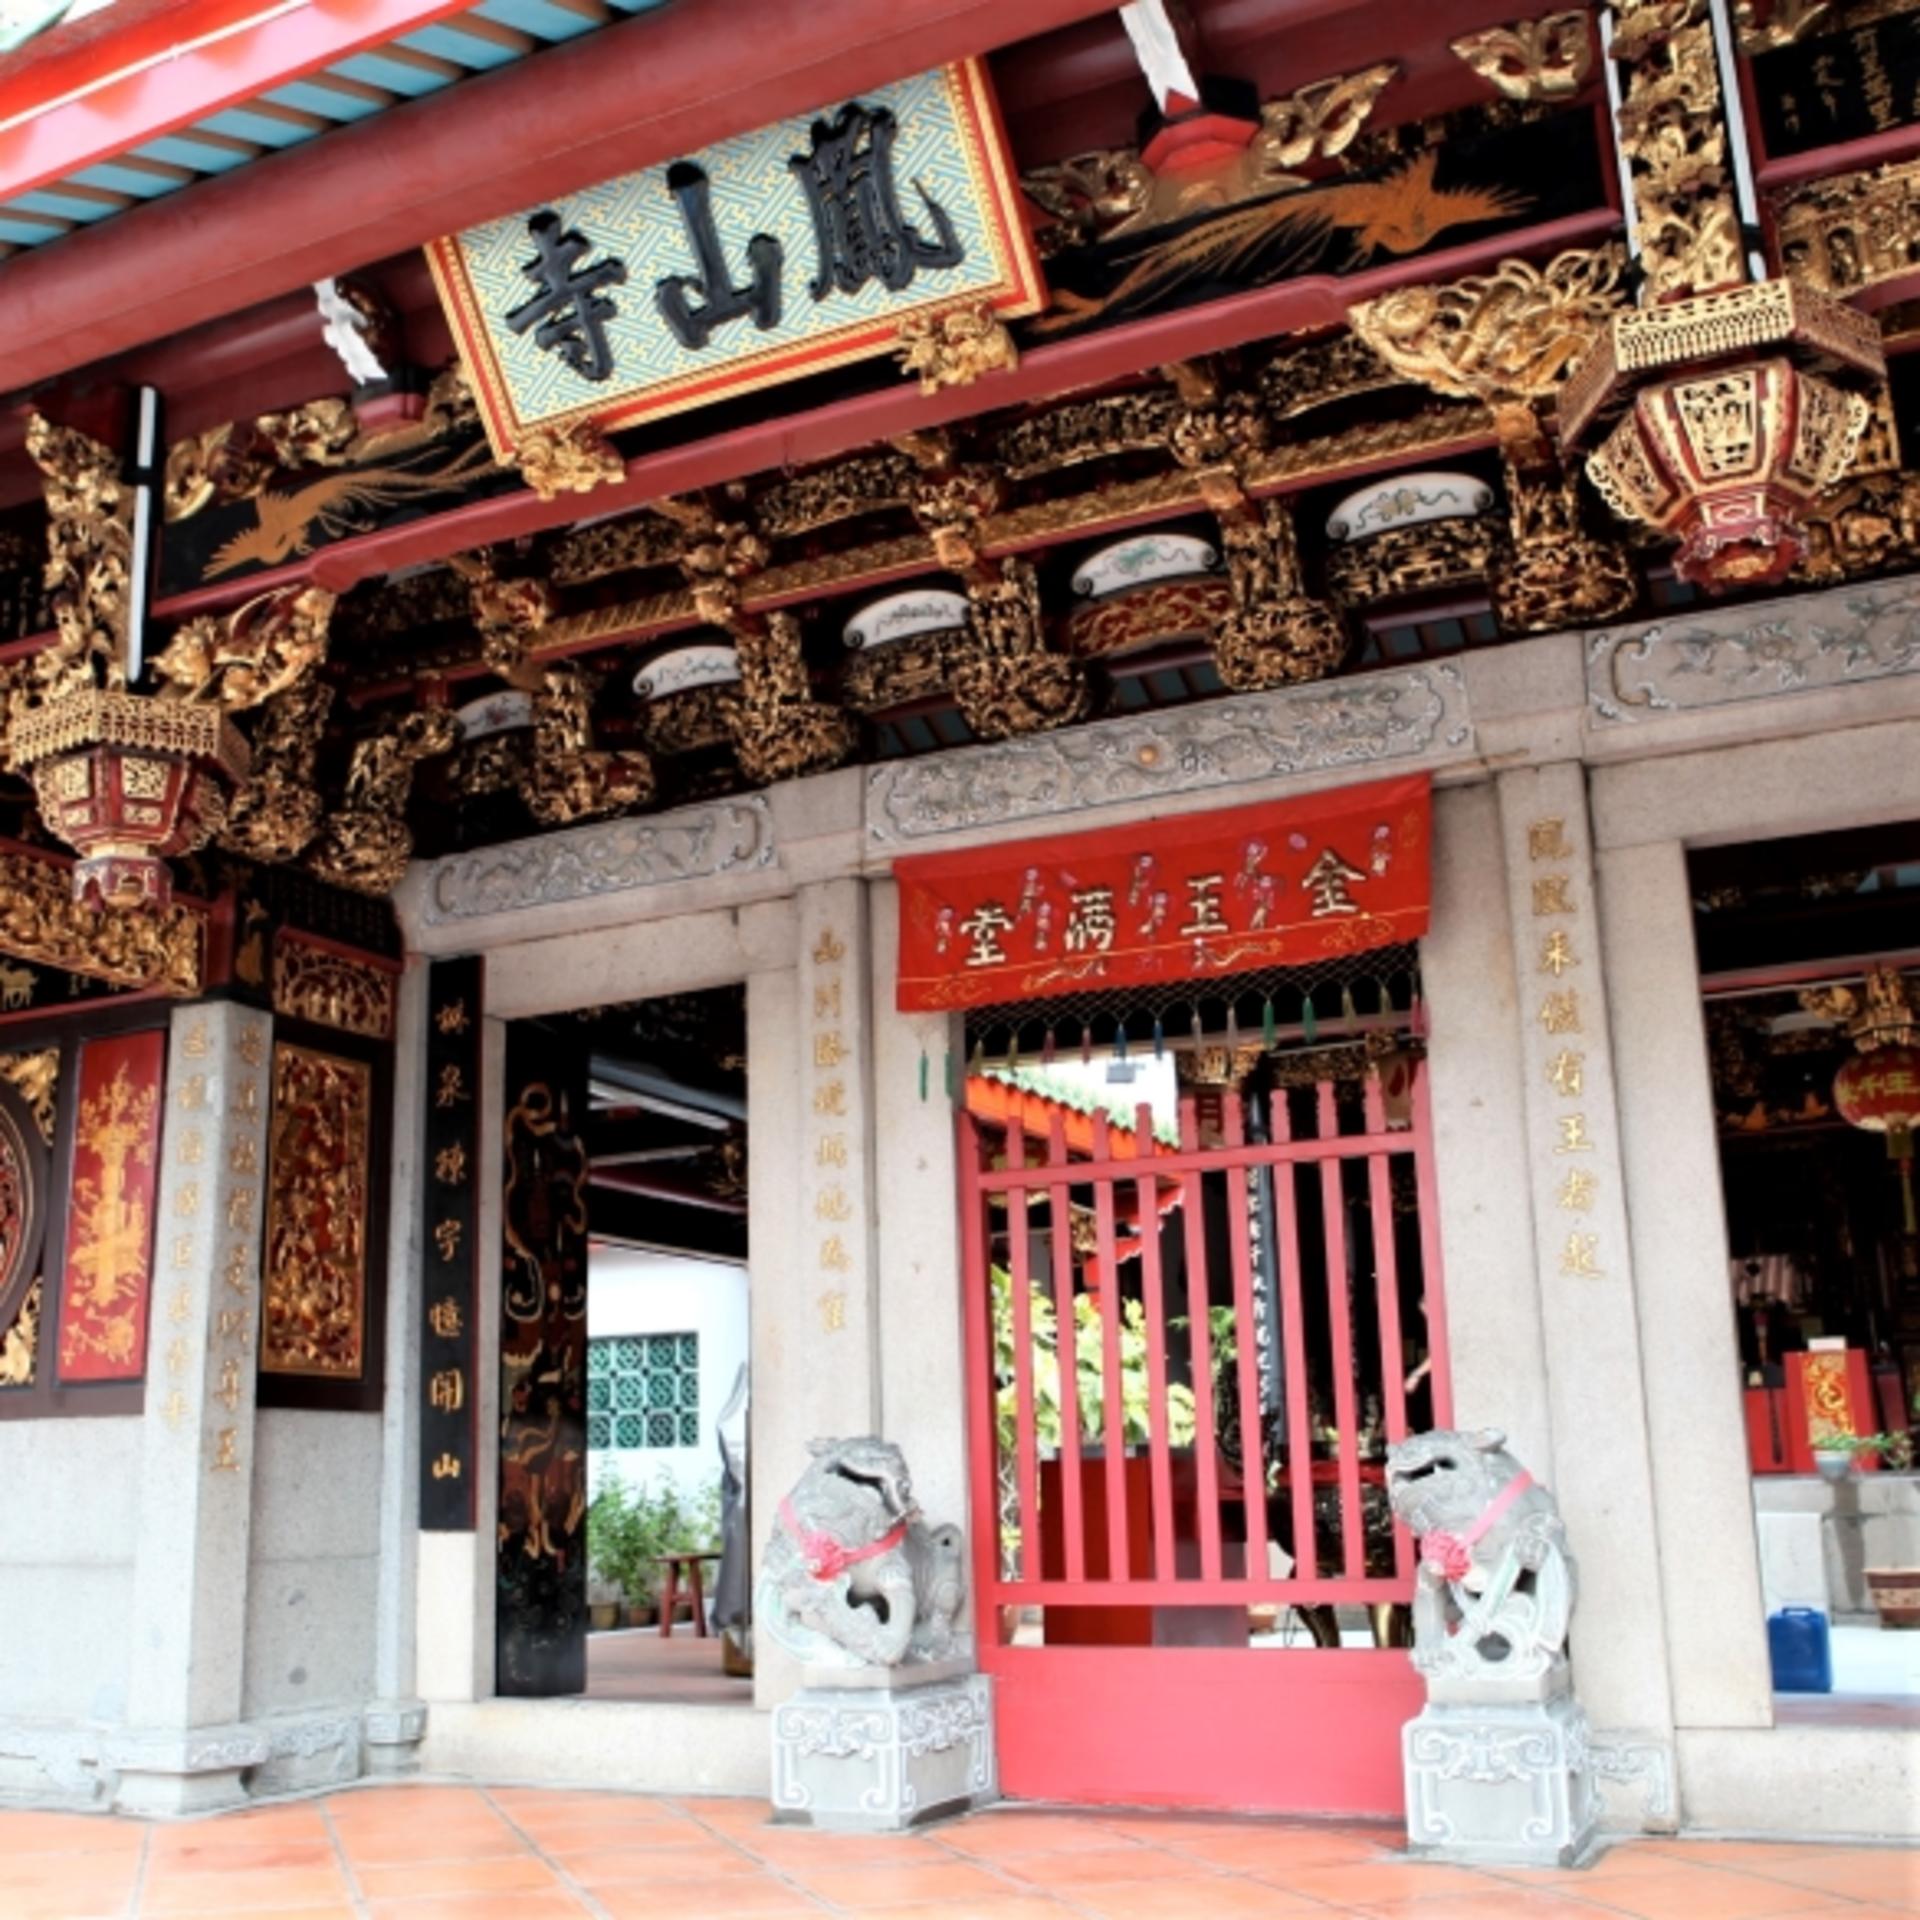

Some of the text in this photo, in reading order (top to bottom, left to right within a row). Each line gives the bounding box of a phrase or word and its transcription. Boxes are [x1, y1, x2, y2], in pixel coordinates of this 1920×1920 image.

[505, 101, 965, 381] 鳳山寺
[959, 849, 1367, 967] 金玉滿堂
